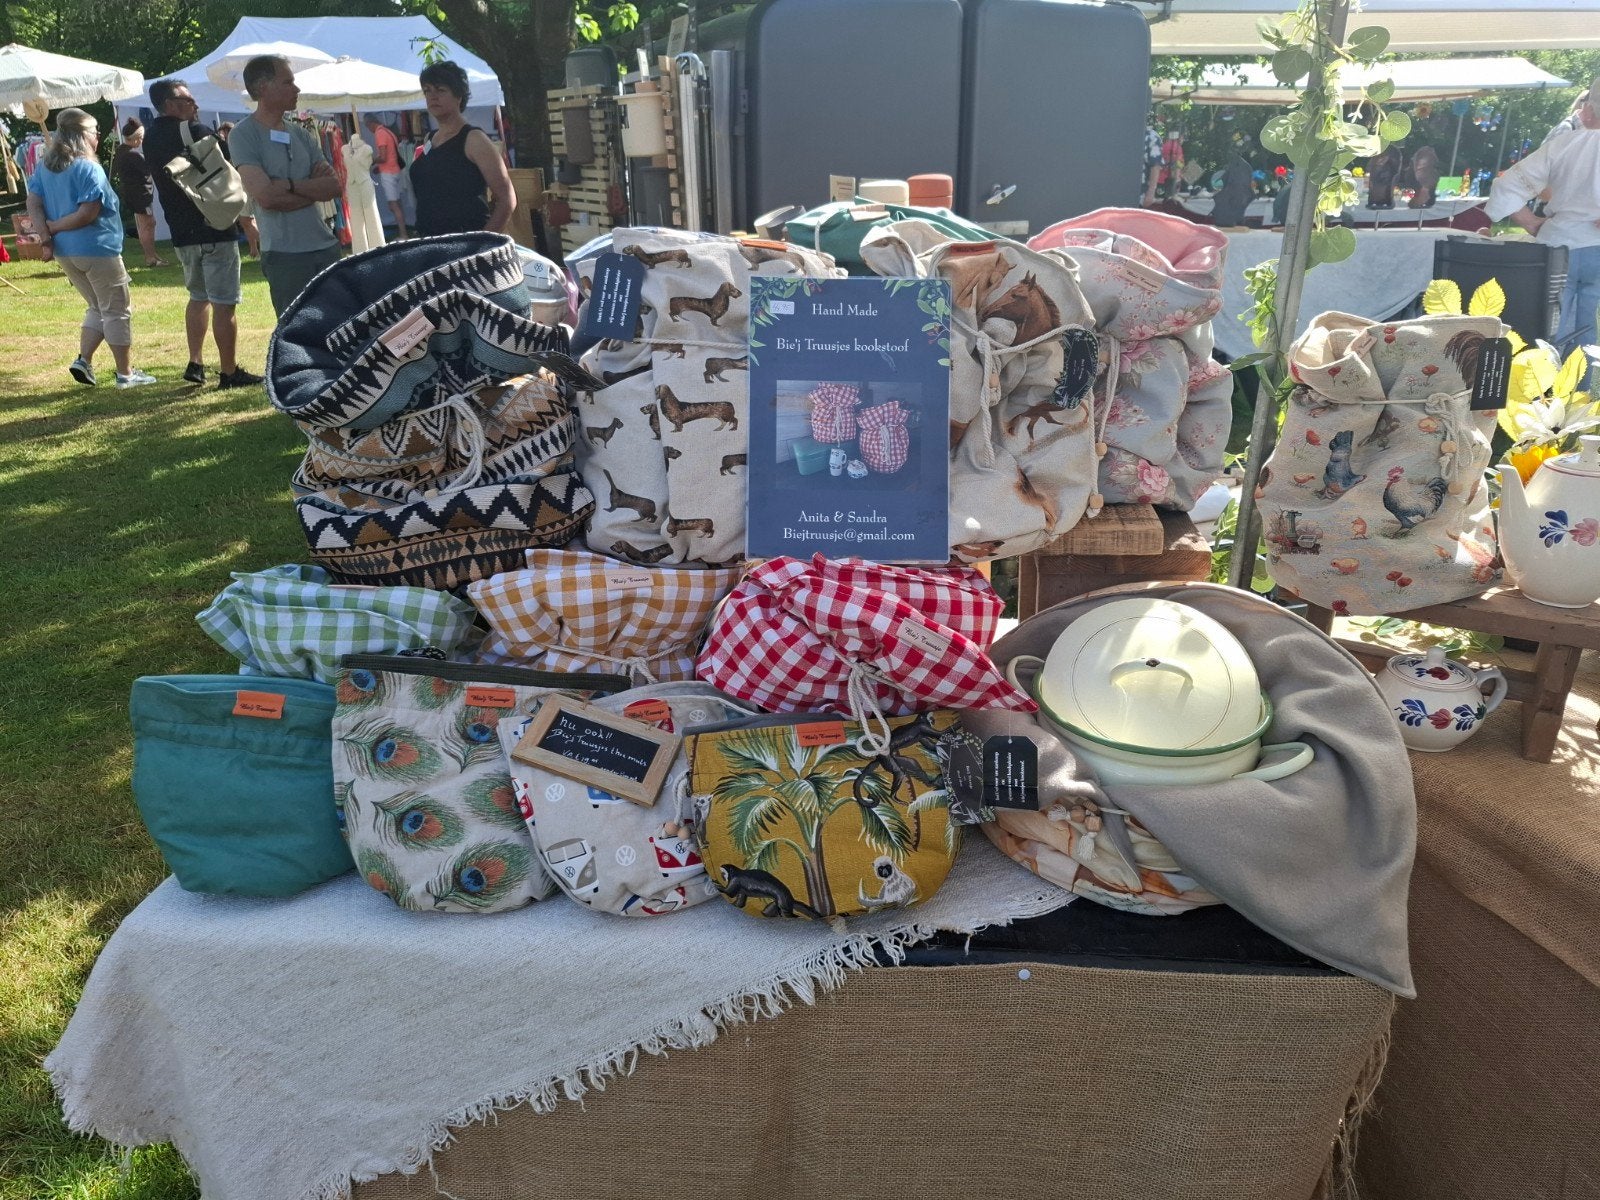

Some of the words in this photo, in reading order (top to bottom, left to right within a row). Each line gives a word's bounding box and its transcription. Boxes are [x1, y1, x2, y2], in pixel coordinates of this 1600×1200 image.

[812, 302, 843, 316] Hand
[847, 303, 879, 316] Made
[776, 337, 801, 352] Bie'j
[804, 338, 850, 353] Truusjes
[854, 337, 910, 352] kookstoof
[798, 510, 830, 523] Anita
[833, 510, 844, 523] &
[847, 509, 888, 523] Sandra
[783, 527, 916, 543] Biejtruusje@gmail.com
